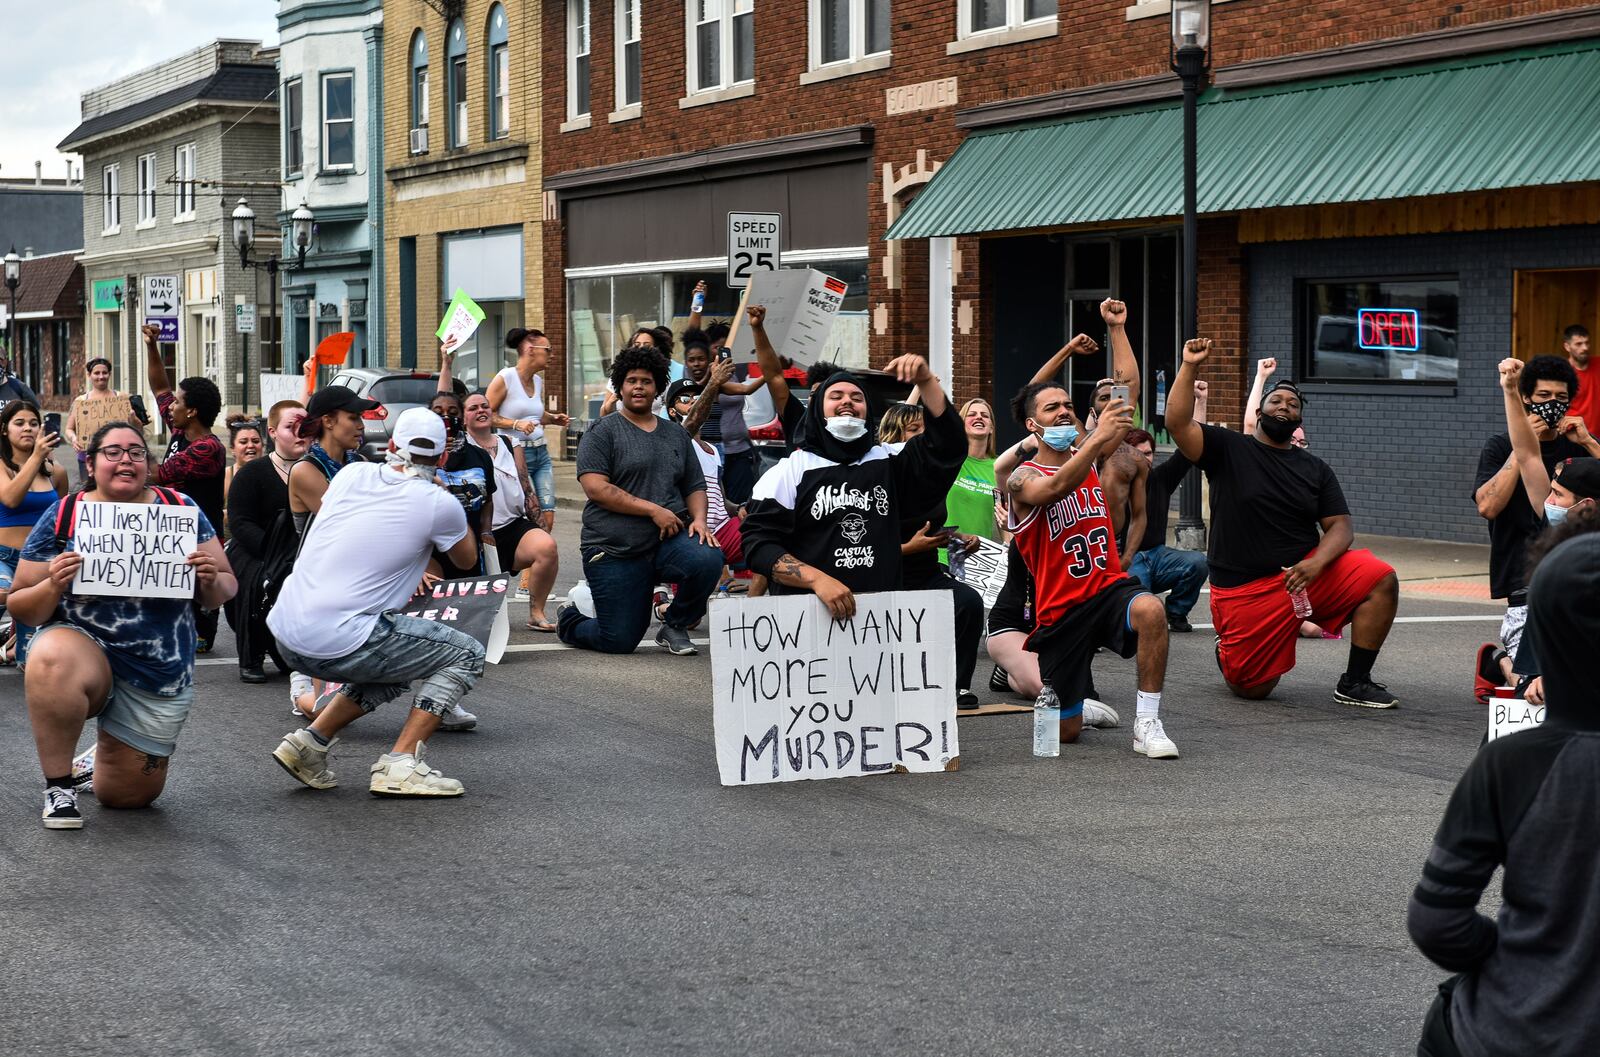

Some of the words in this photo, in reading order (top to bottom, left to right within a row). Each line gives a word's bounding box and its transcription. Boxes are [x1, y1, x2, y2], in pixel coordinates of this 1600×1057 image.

[733, 221, 777, 233] SPEED
[738, 237, 771, 248] LIMIT
[733, 252, 775, 278] 25
[150, 279, 173, 288] ONE
[150, 290, 173, 299] WAY
[1361, 312, 1416, 346] OPEN
[90, 403, 127, 419] BLACK
[79, 503, 102, 529] All
[113, 505, 143, 532] lives
[146, 506, 196, 534] MATTER
[1046, 487, 1107, 542] BULLS
[78, 533, 123, 553] WHEN
[131, 533, 185, 556] BLACK
[834, 545, 874, 559] CASUAL
[1062, 526, 1109, 578] 33
[81, 557, 126, 587] LIVES
[128, 555, 191, 591] MATTER
[432, 579, 508, 599] LIVES
[723, 611, 804, 652] HOW
[828, 608, 926, 647] MANY
[849, 652, 942, 695] WILL
[1495, 704, 1545, 725] BLAC
[741, 721, 948, 782] MURDER!
